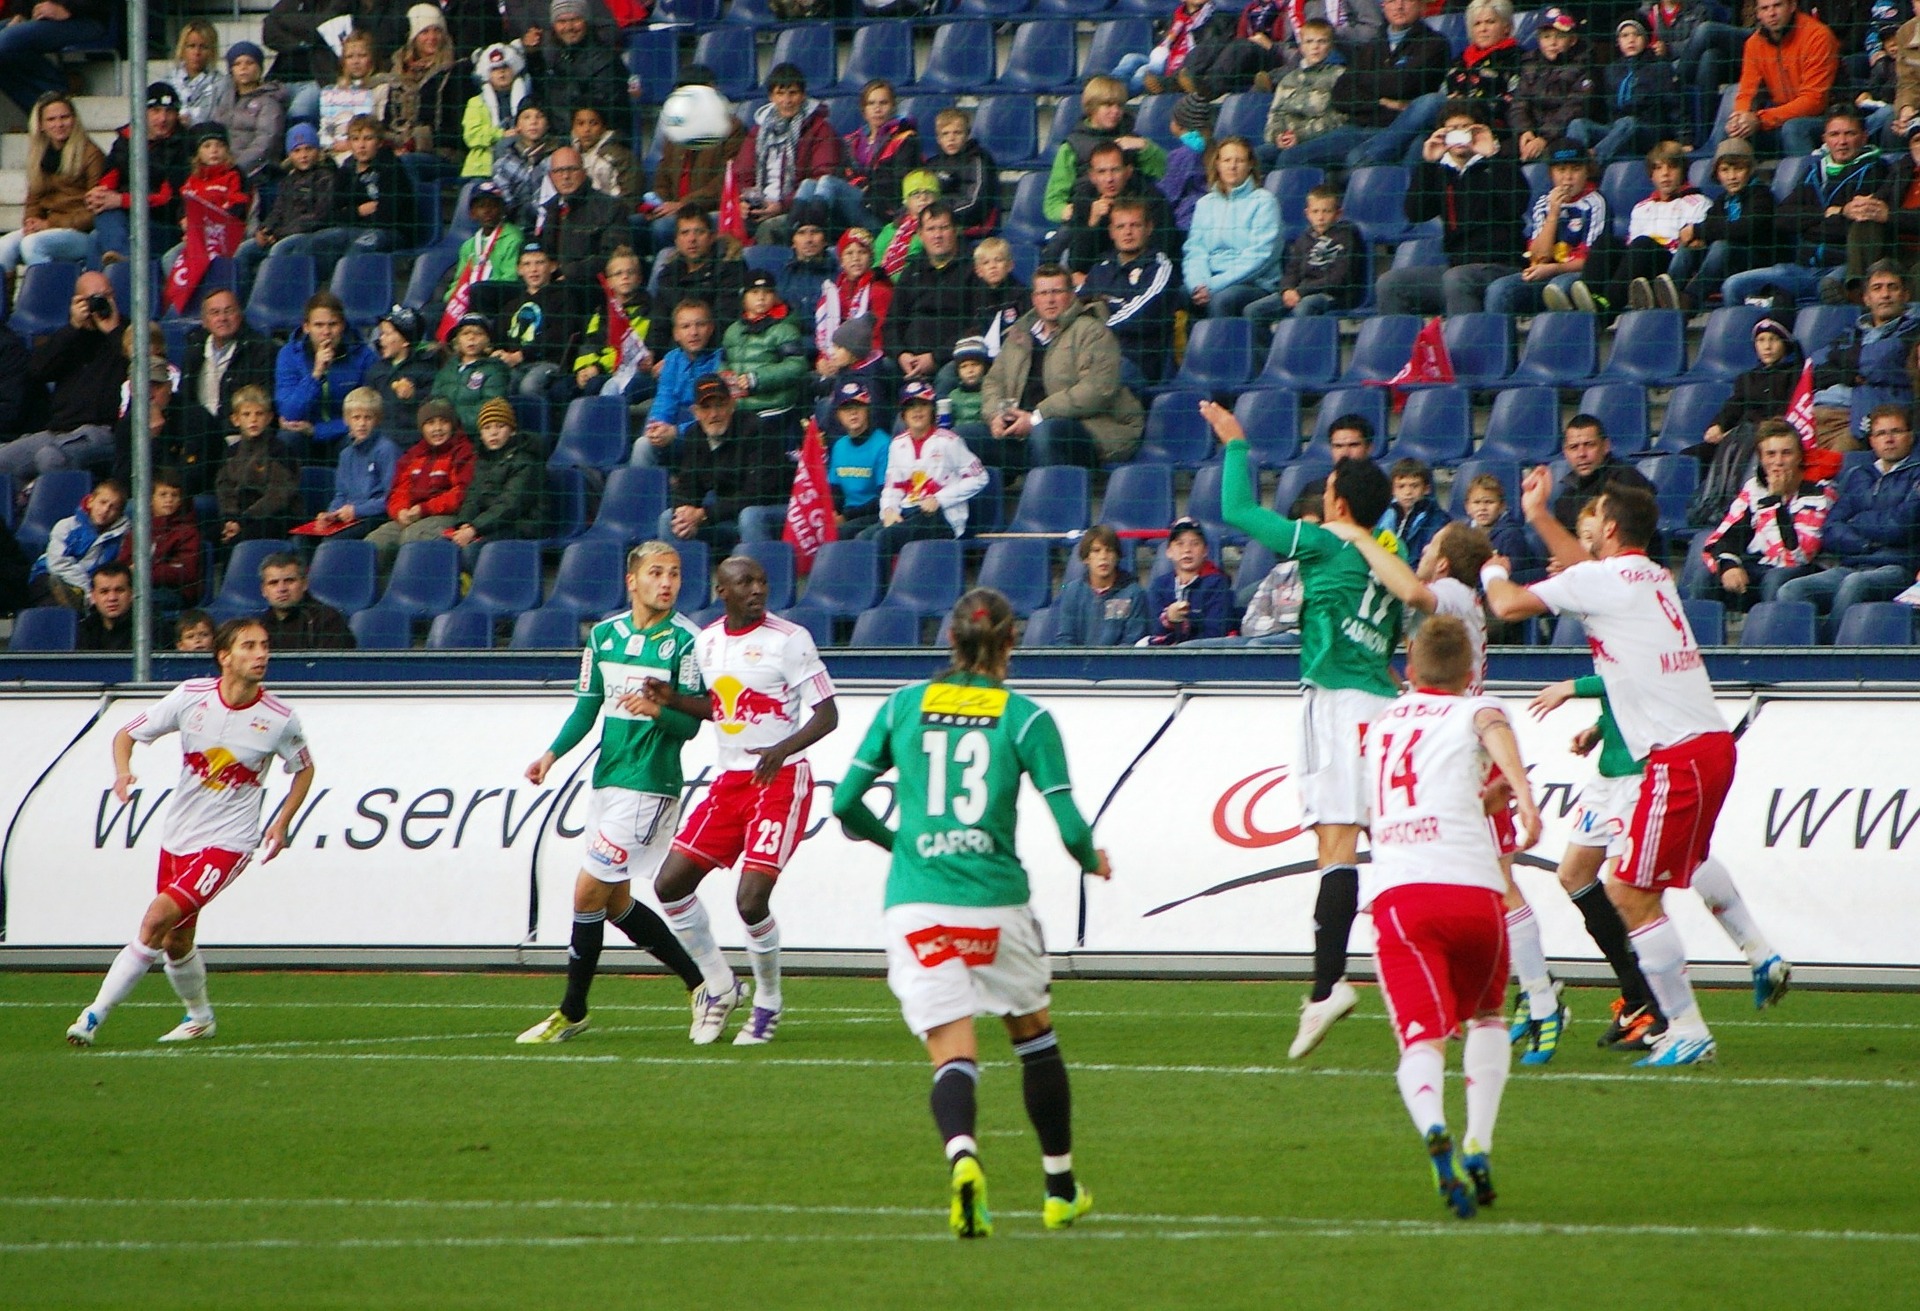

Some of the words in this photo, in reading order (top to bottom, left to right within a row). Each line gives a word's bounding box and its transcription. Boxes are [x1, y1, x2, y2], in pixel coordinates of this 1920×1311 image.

[1655, 589, 1688, 648] 9
[922, 730, 991, 826] 13
[1379, 728, 1419, 816] 14
[752, 818, 783, 856] 23
[193, 863, 222, 897] 18
